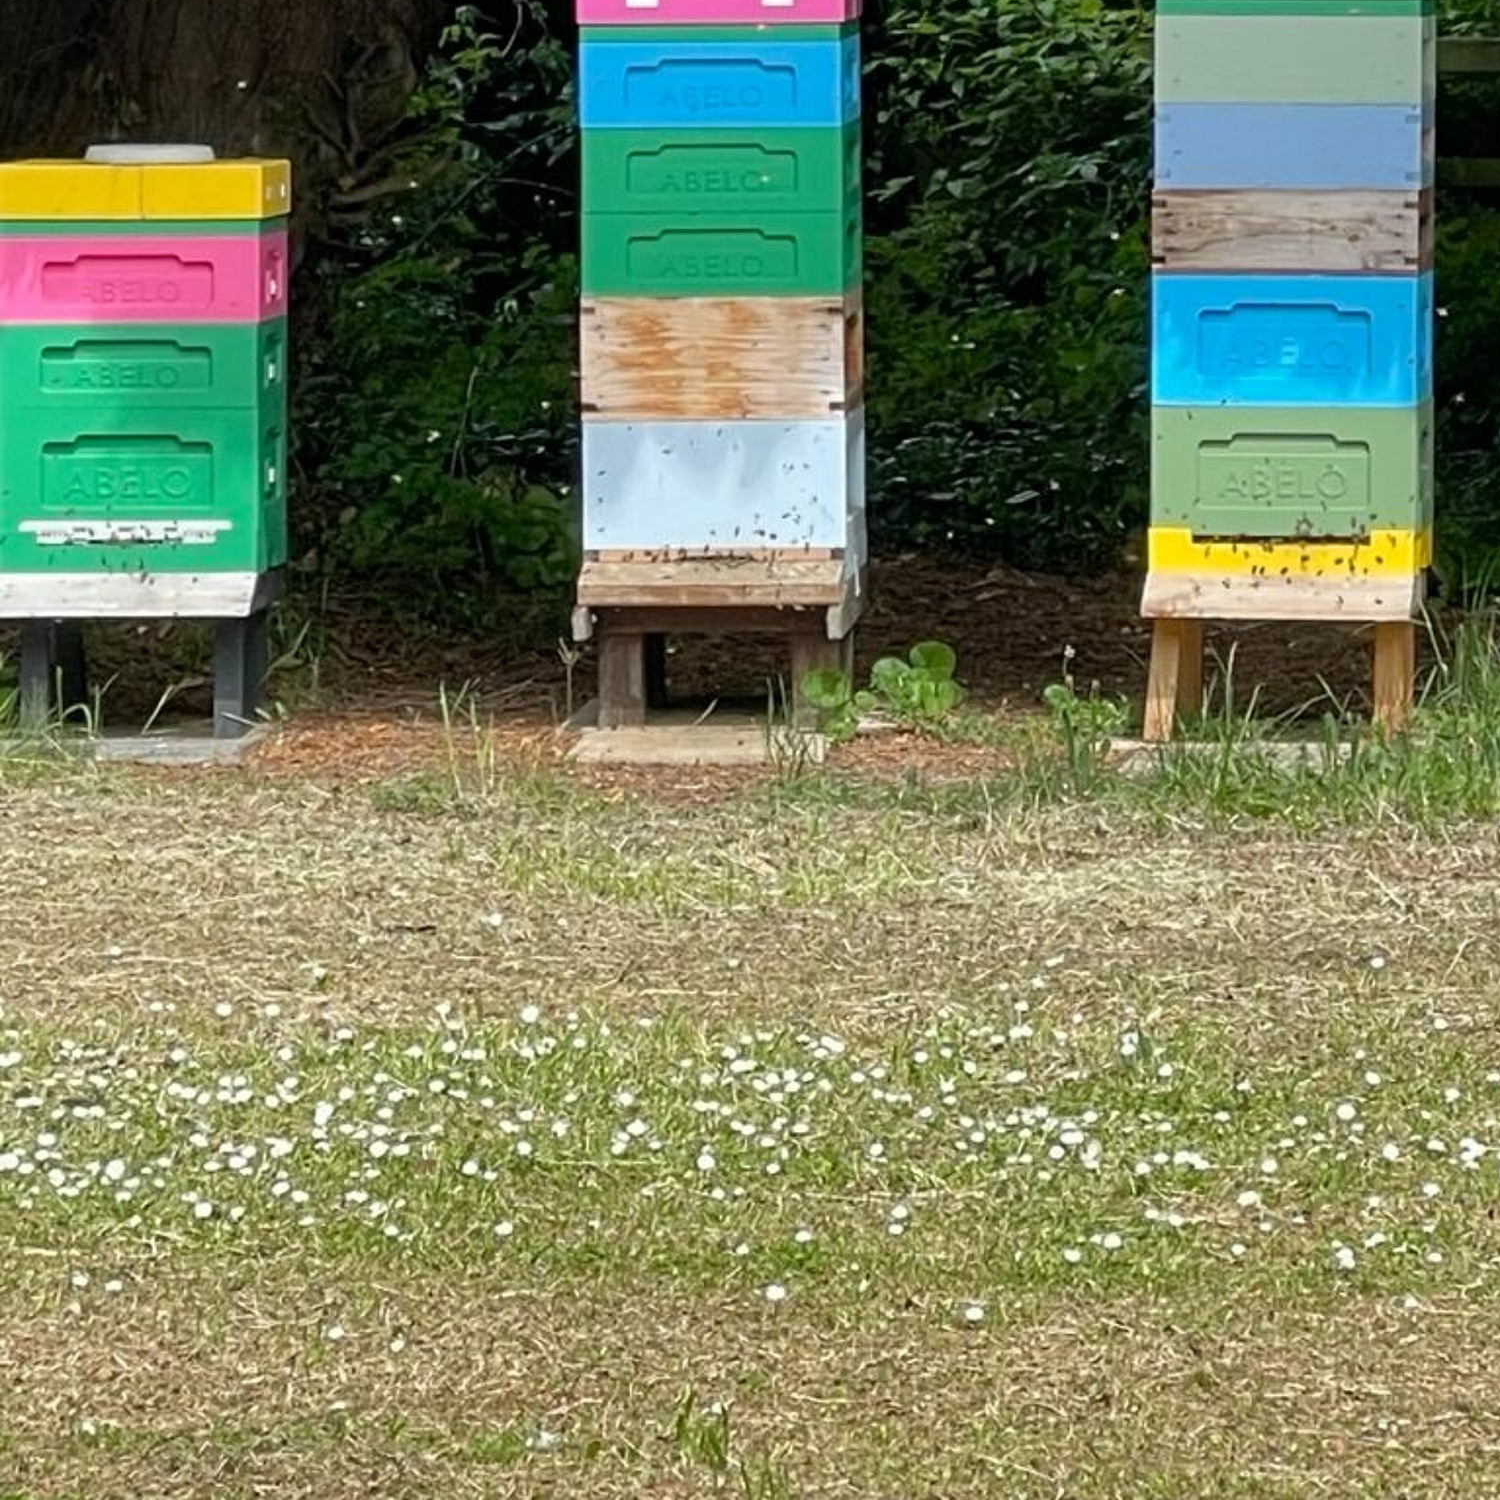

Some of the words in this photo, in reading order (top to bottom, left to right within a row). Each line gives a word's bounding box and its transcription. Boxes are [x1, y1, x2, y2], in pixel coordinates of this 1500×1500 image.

[660, 170, 765, 193] ABELO
[660, 255, 765, 279] ABELO
[81, 280, 180, 304] ABELO
[1222, 338, 1347, 372] ABELO
[74, 366, 179, 389] ABELO
[63, 469, 192, 501] ABELO
[1218, 466, 1347, 501] ABELO
